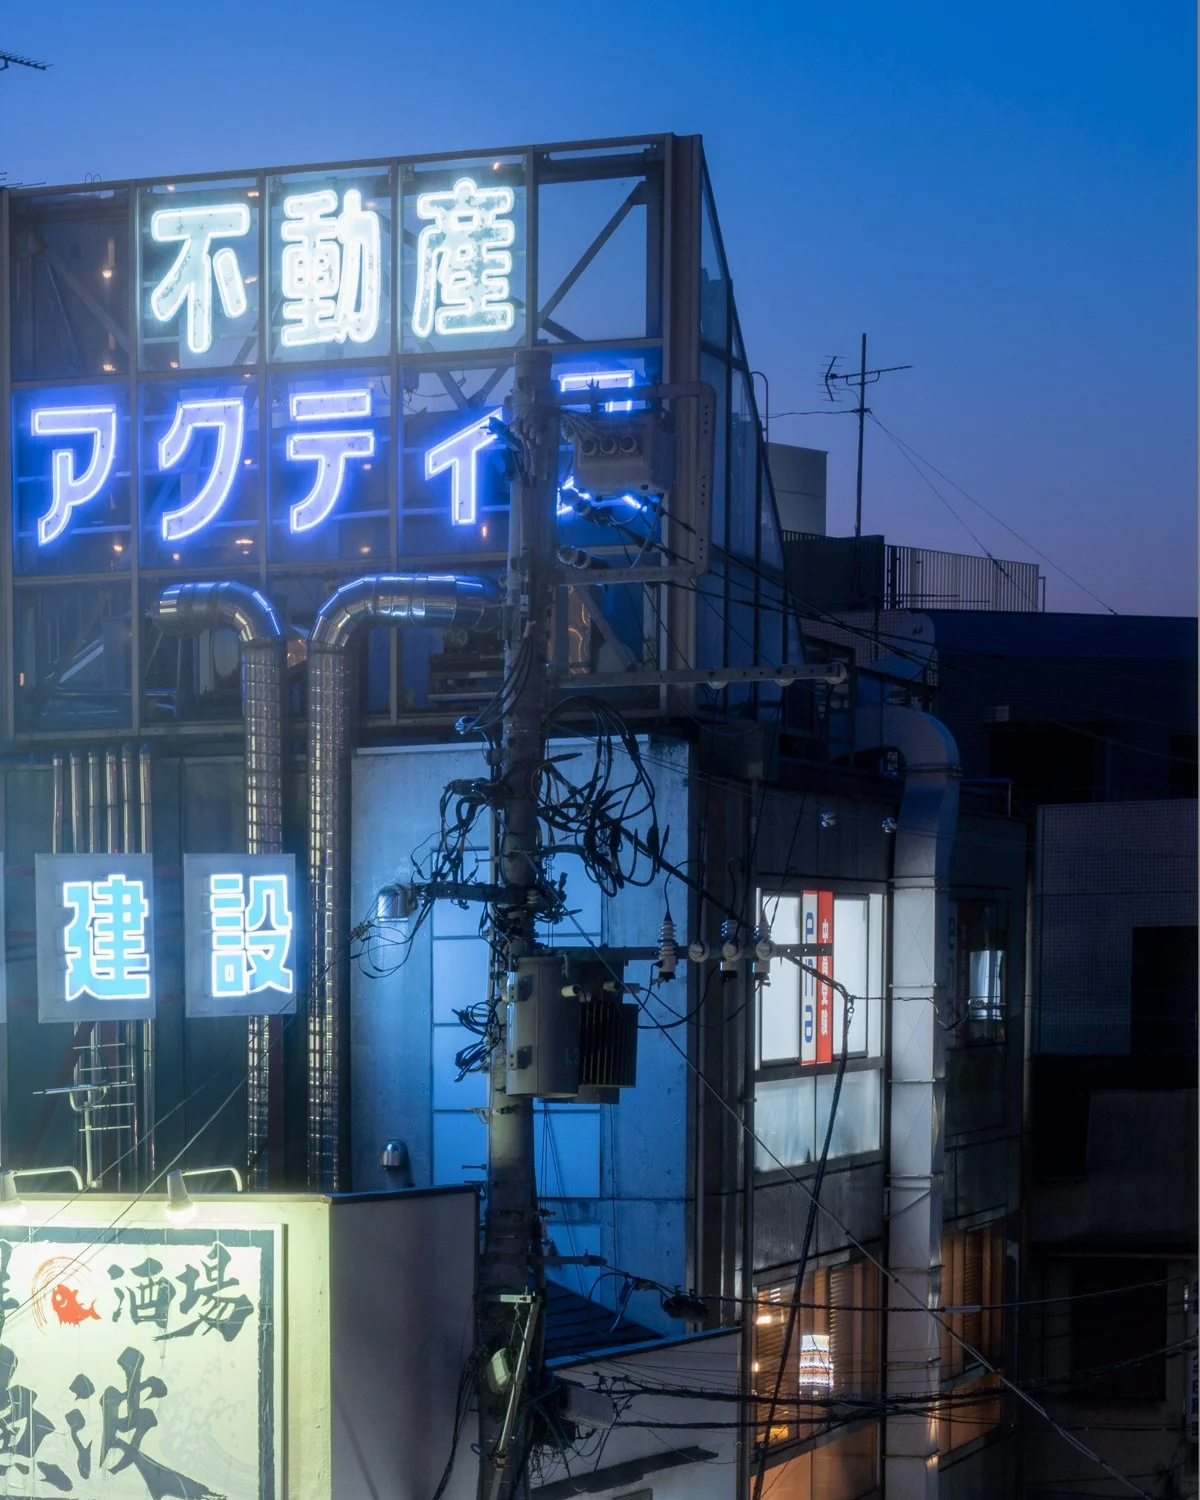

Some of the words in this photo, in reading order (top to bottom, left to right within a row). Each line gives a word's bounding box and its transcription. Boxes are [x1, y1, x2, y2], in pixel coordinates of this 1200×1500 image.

[150, 176, 515, 354] 不動産
[106, 1242, 257, 1342] 酒場
